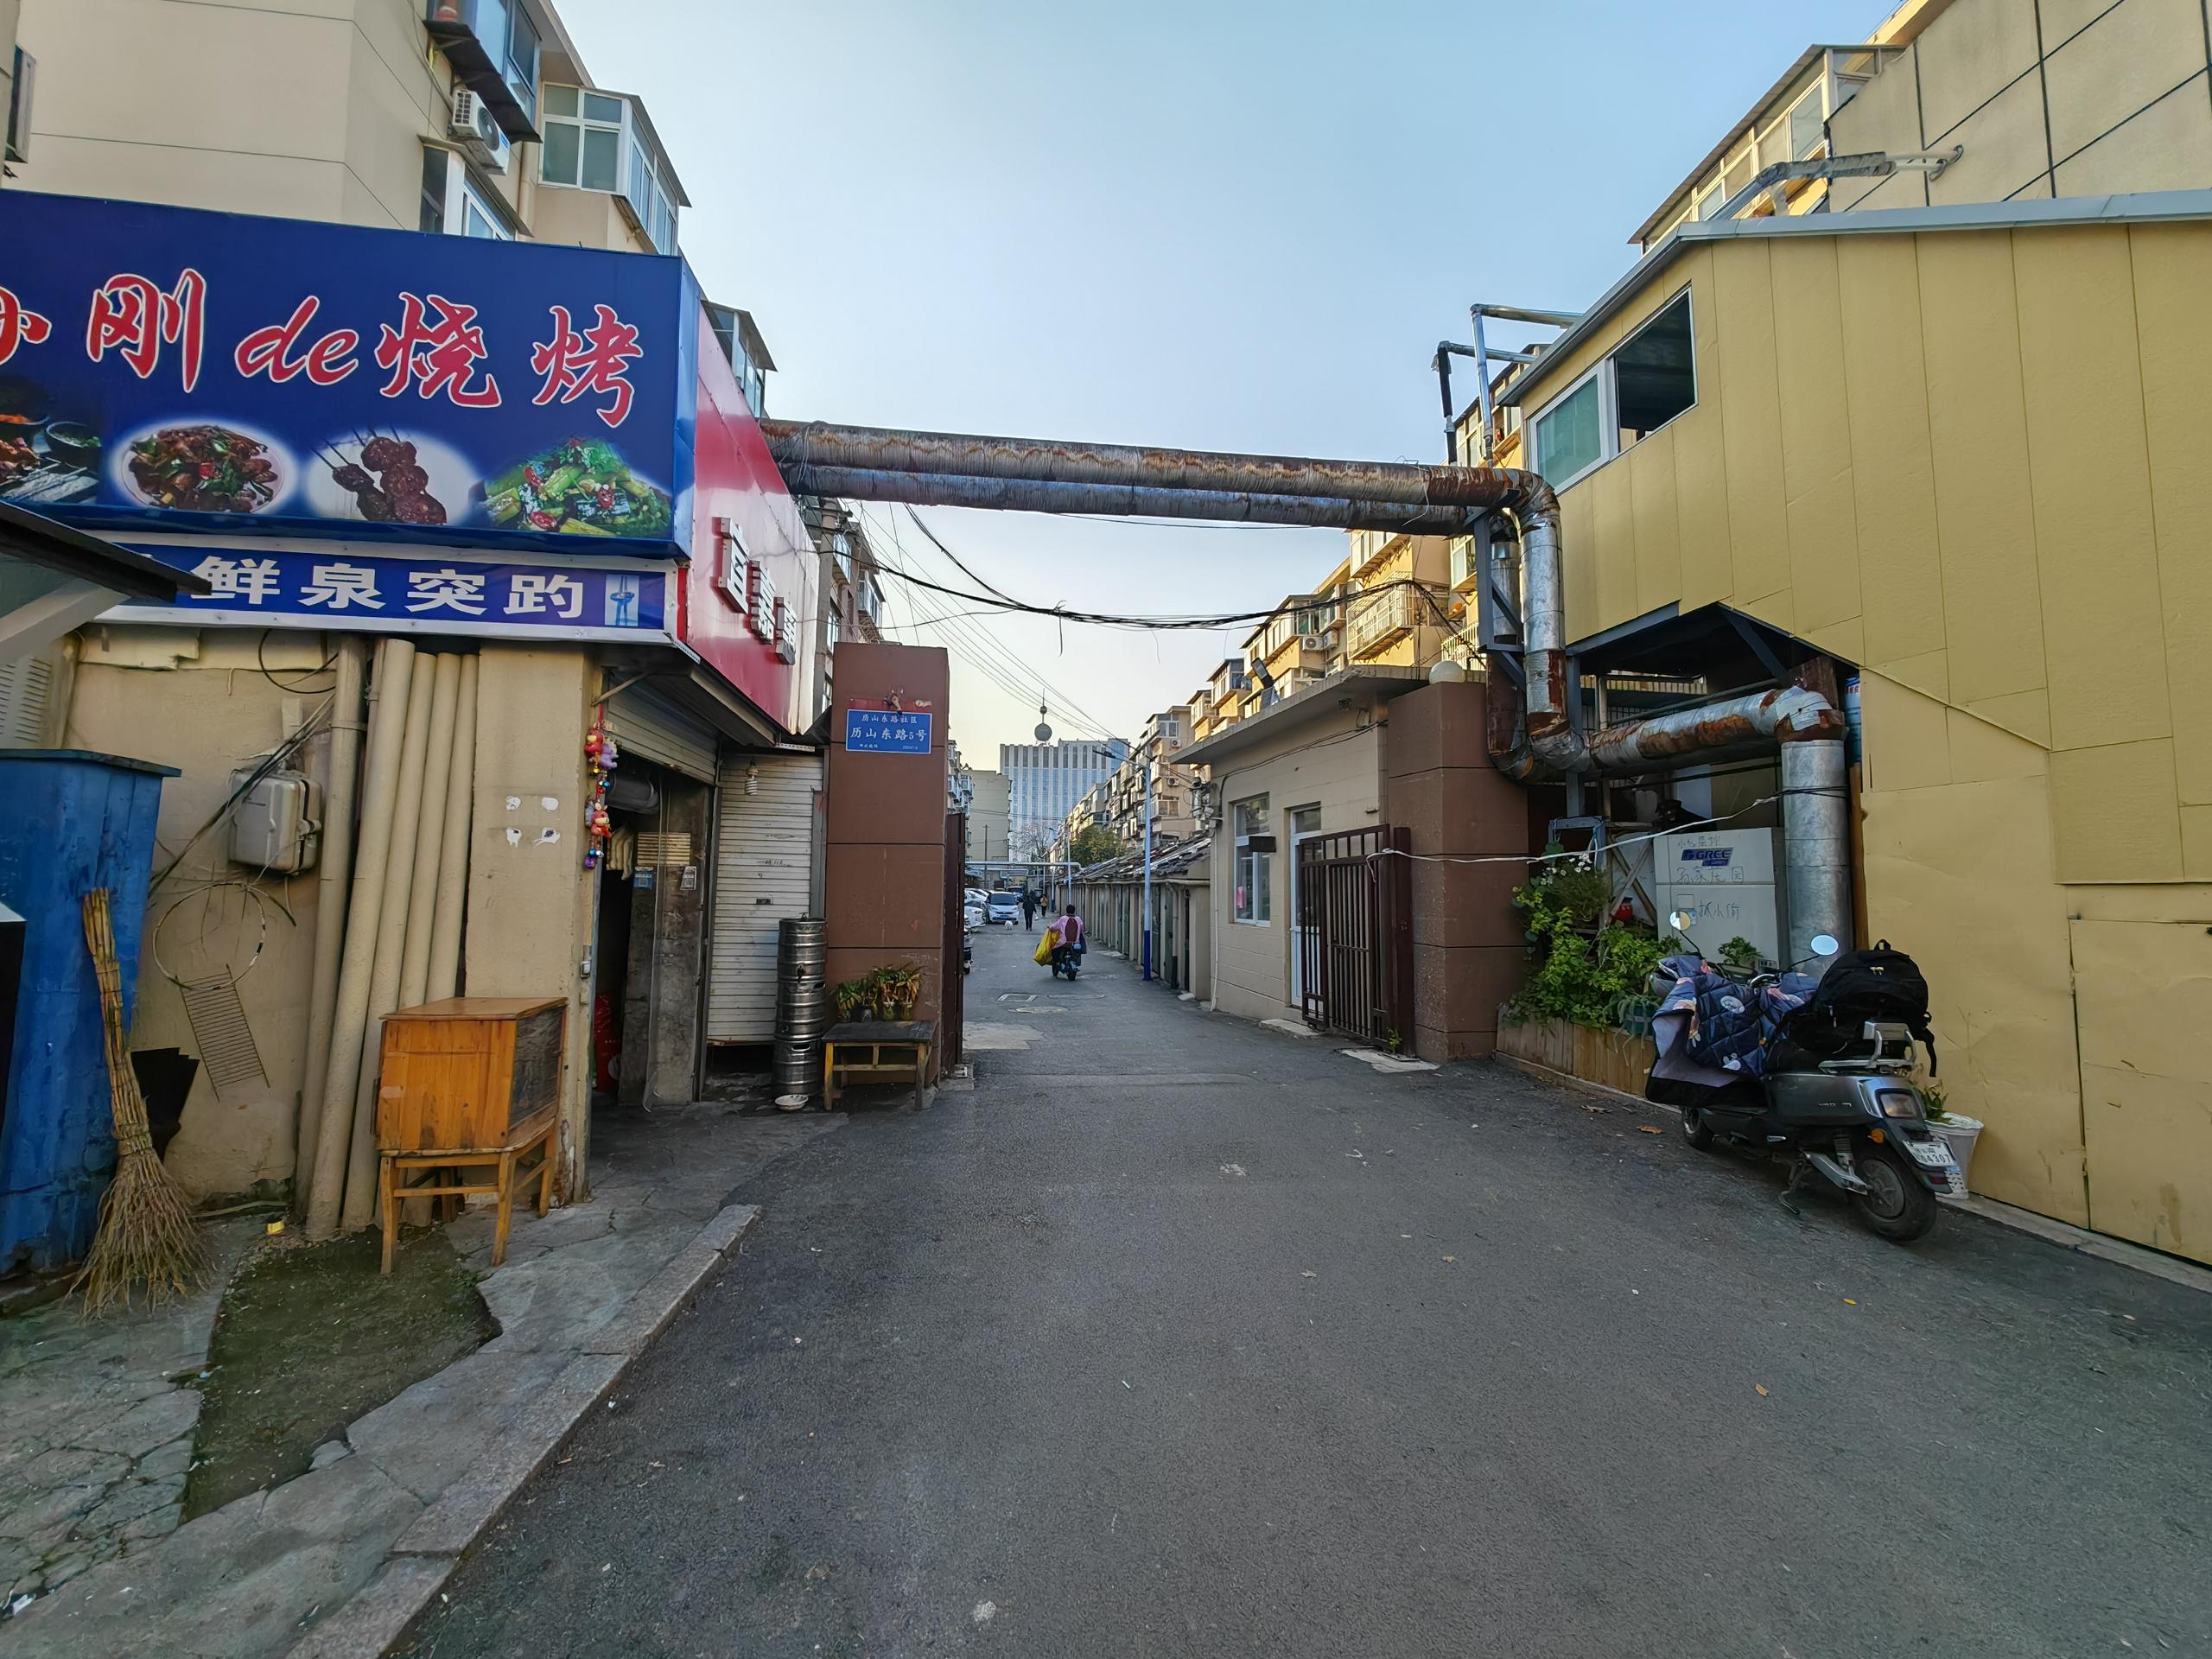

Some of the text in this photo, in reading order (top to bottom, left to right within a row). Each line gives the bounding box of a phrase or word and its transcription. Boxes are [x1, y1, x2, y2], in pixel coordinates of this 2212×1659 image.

[861, 714, 918, 724] 历山东路社区
[850, 727, 927, 741] 历山东路5号
[1696, 849, 1732, 860] GREE
